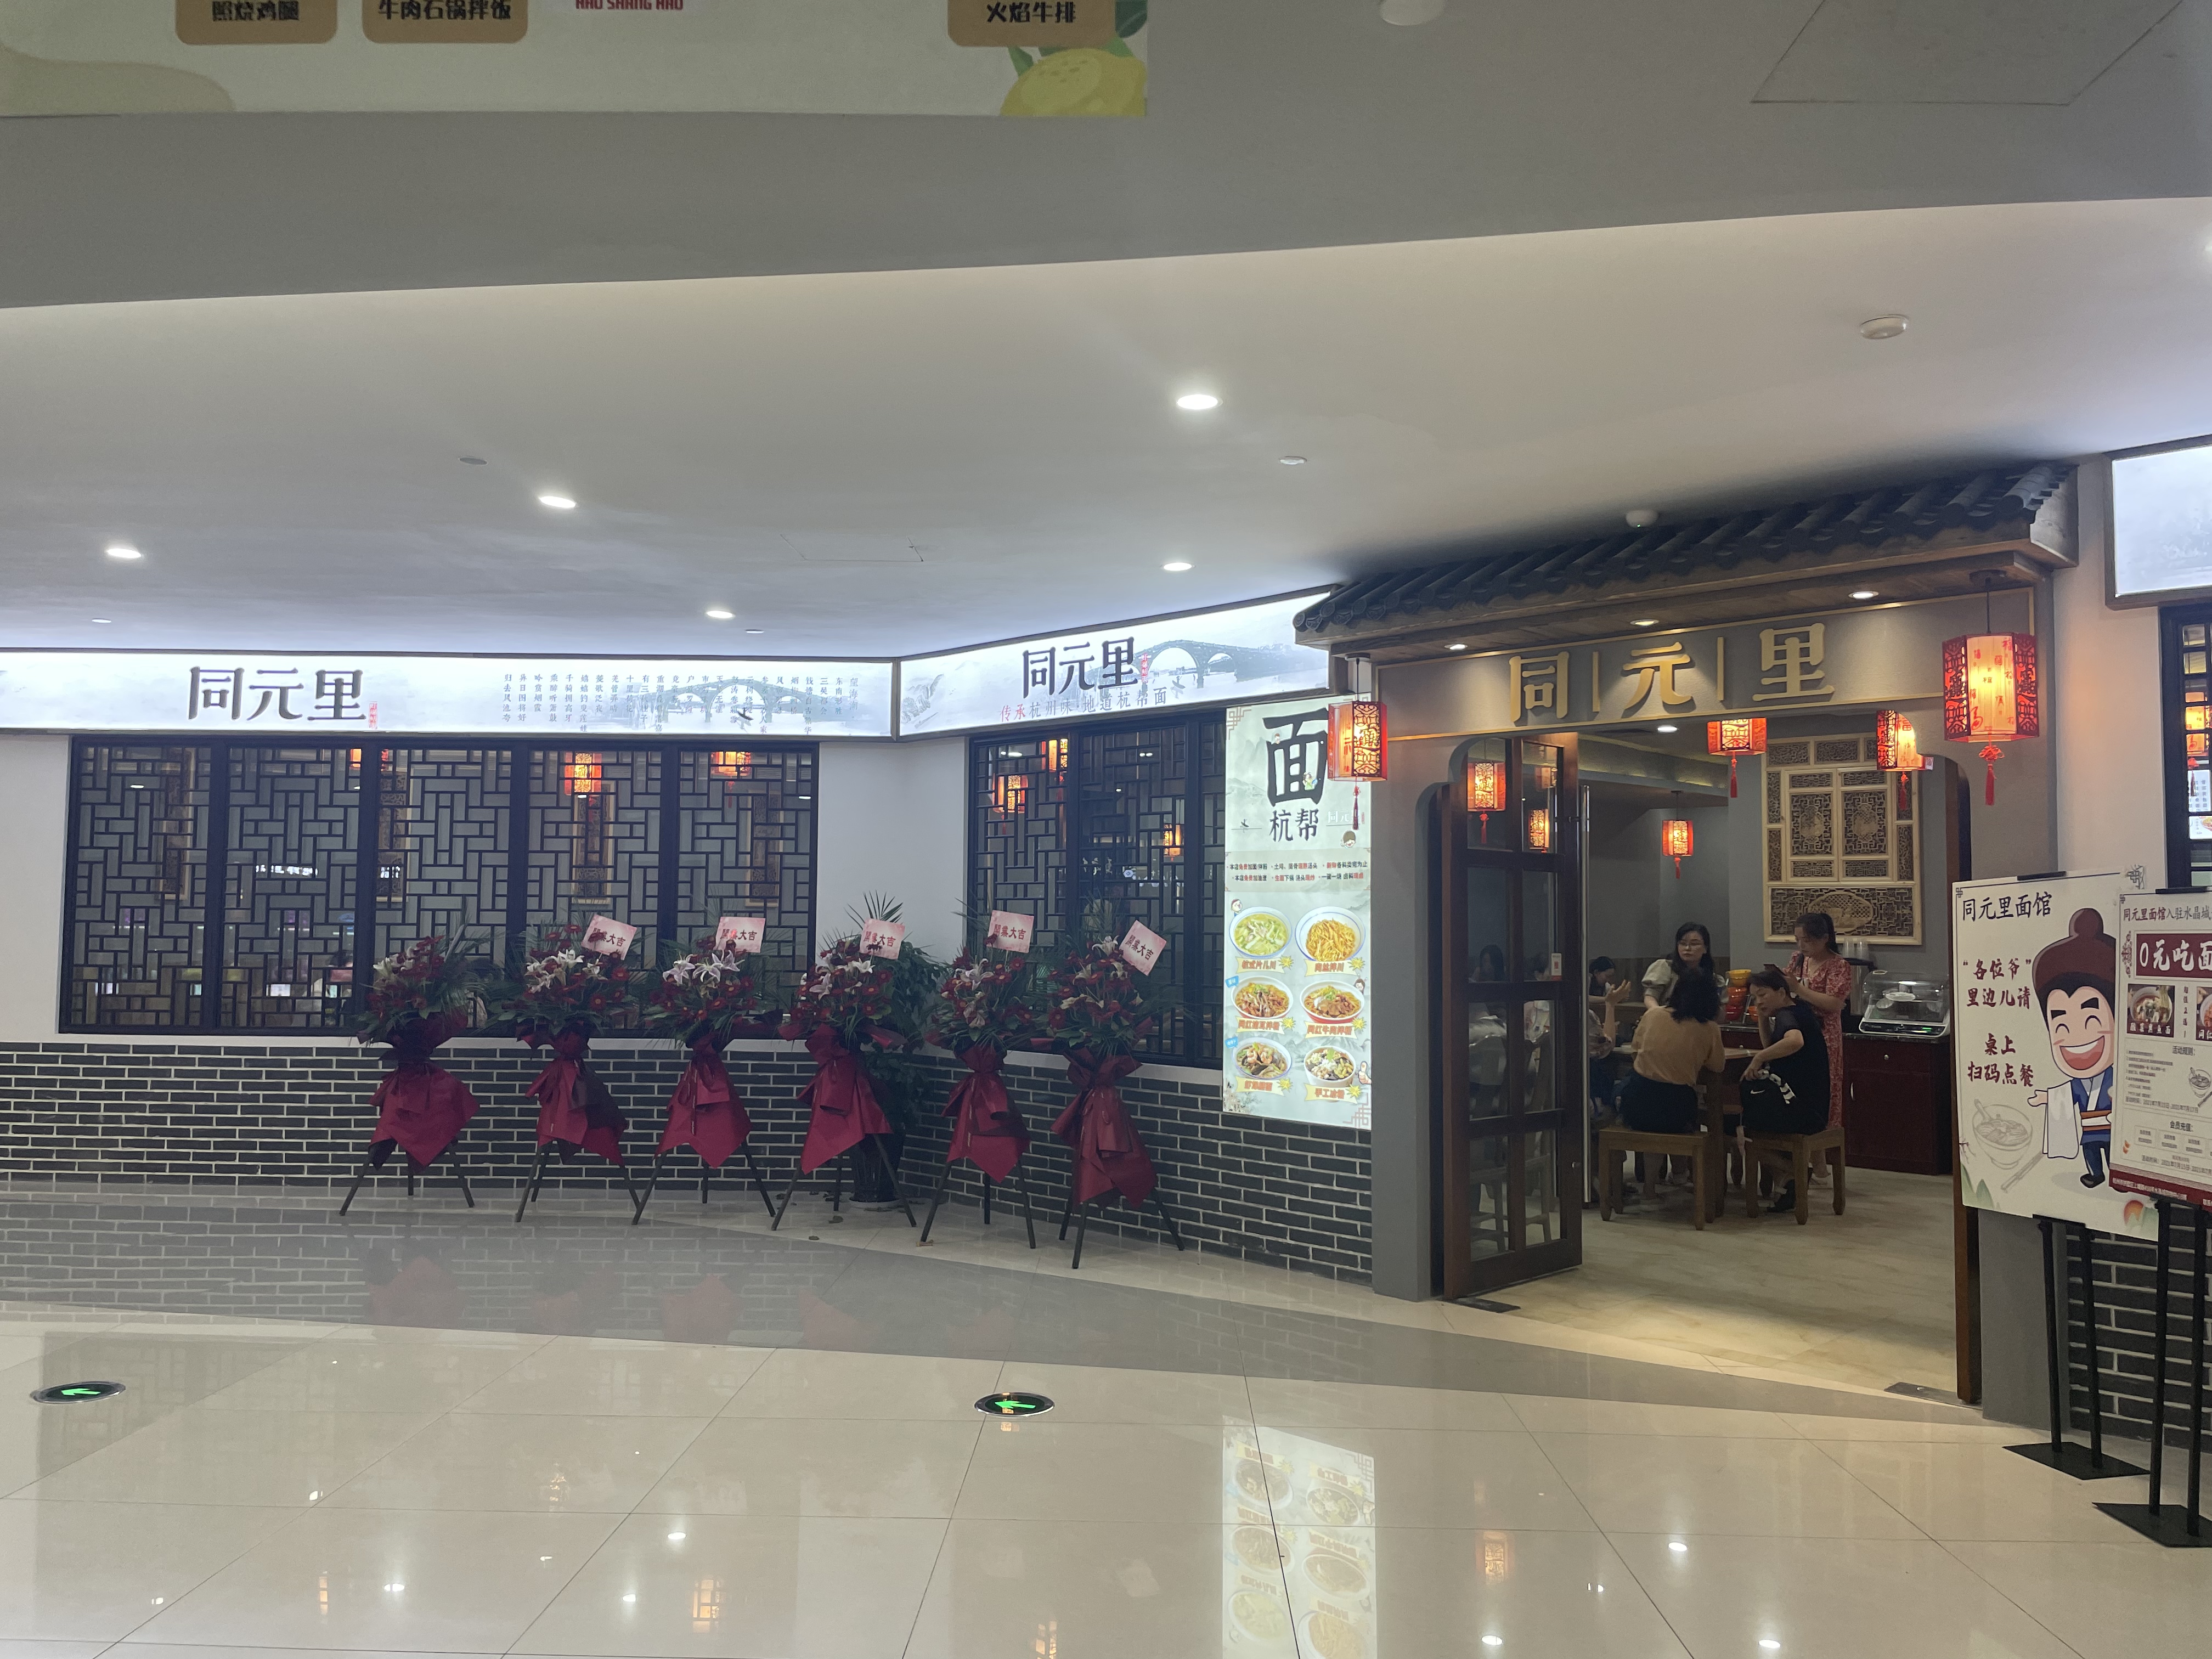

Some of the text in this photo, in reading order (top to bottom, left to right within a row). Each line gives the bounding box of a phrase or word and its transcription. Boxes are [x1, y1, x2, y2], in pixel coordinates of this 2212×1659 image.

[212, 1, 299, 21] 照烧鸡腿
[377, 0, 511, 20] 牛肉石锅拌饭
[987, 1, 1076, 23] 火焰牛排
[1023, 636, 1138, 698] 同元里
[1509, 623, 1835, 722] 同元里
[189, 666, 366, 720] 同元里
[820, 677, 828, 715] 三吴都会
[834, 677, 843, 715] 东南形胜
[1262, 707, 1329, 807] 面
[1268, 808, 1319, 843] 杭帮
[1963, 891, 2052, 922] 同元里面馆
[2123, 905, 2212, 922] 同元里面馆入驻水晶城
[993, 924, 1026, 940] 開業大吉
[1125, 934, 1154, 961] 開業大吉
[2140, 939, 2212, 972] 0元吃面
[1967, 986, 2031, 1009] 里边儿请
[1984, 1033, 2016, 1056] 桌上
[1967, 1061, 2034, 1087] 扫码点餐
